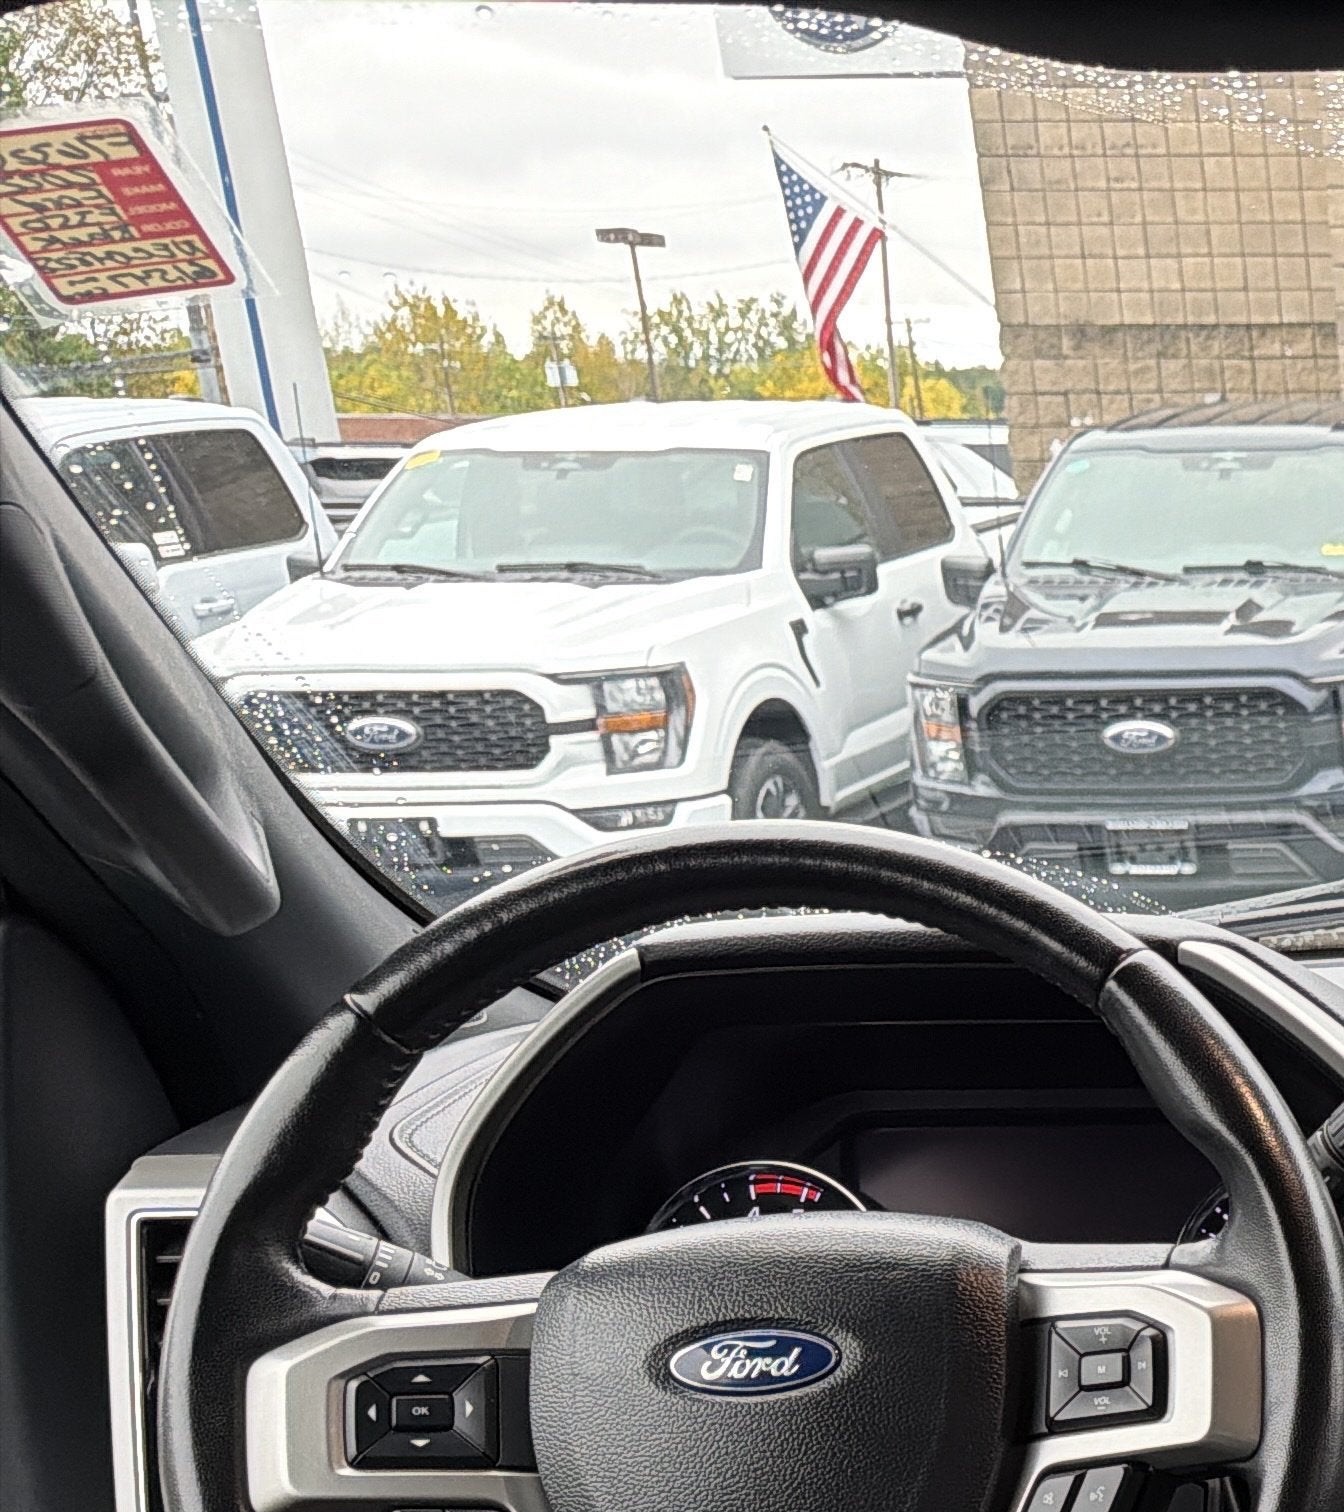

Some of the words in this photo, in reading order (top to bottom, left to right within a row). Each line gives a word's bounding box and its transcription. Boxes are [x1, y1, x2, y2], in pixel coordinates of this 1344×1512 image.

[1093, 1326, 1111, 1336] VOL
[700, 1337, 802, 1381] Ford
[1097, 1365, 1106, 1374] M
[1093, 1396, 1110, 1406] VOL
[411, 1404, 430, 1418] OK
